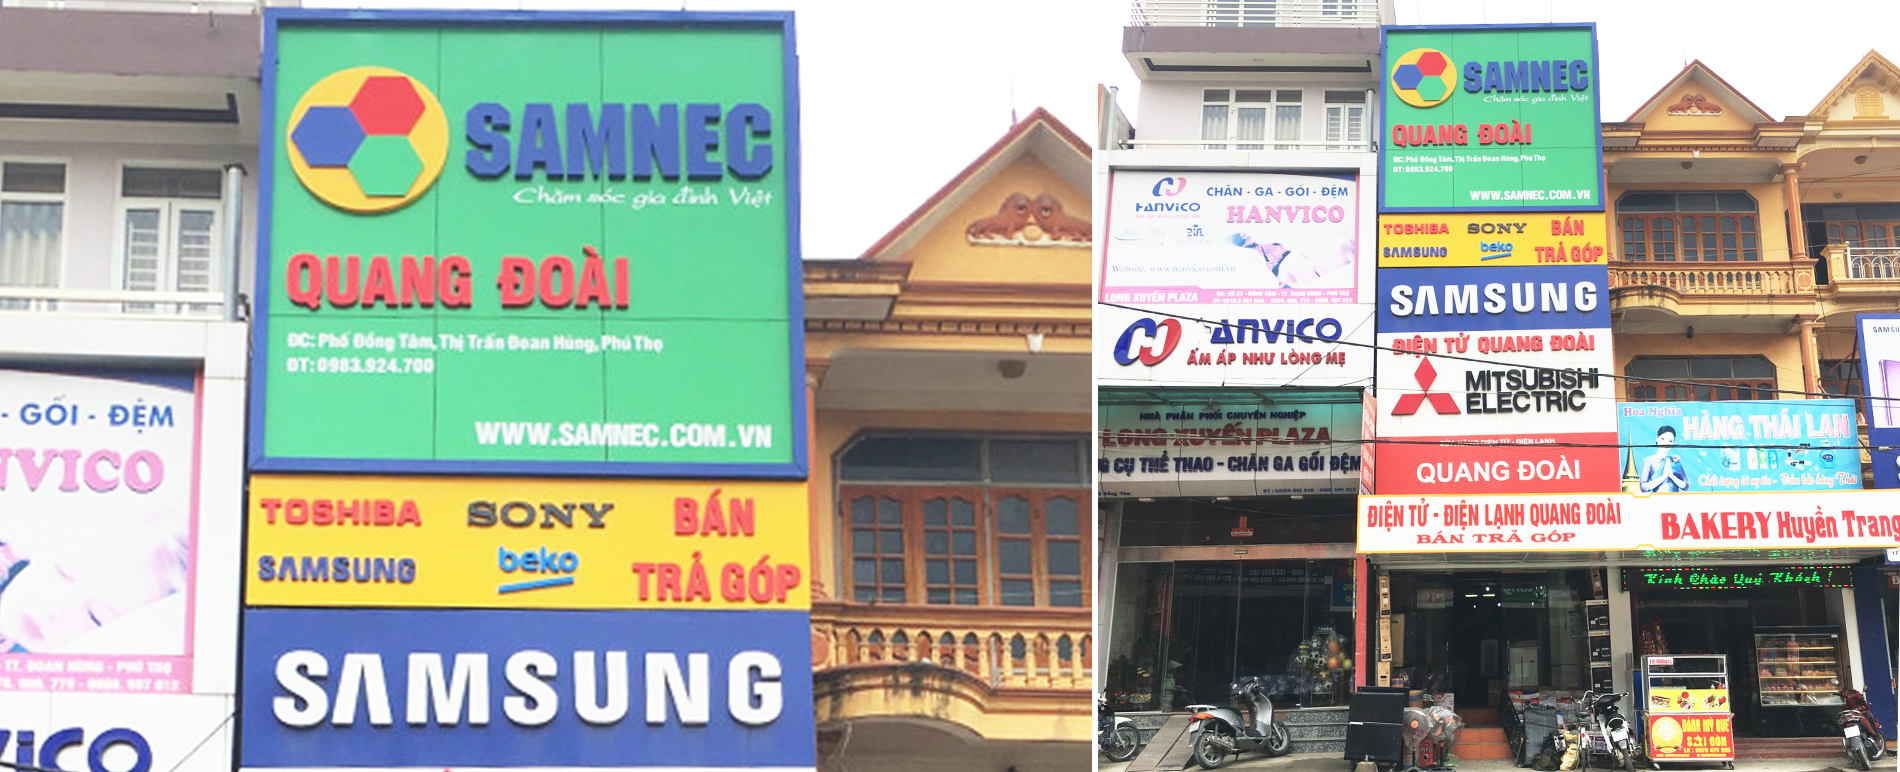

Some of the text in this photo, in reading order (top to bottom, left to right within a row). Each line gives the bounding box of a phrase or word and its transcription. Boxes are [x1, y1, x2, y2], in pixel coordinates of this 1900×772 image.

[1464, 59, 1589, 94] SAMNEC
[1531, 96, 1547, 105] gia
[1548, 93, 1567, 103] đình
[1571, 93, 1588, 104] Việt
[465, 102, 773, 183] SAMNEC
[1392, 118, 1532, 148] QUANG ĐOÀI
[1454, 155, 1465, 164] Thị
[1482, 155, 1500, 163] Đoan
[513, 184, 772, 210] Chăm sóc gia đình Việt
[1206, 184, 1349, 199] CHĂN GA GỐI ĐỆM
[1470, 190, 1591, 200] WWW.SAMNEC.COM.VN
[1226, 204, 1345, 224] HANVICO
[1384, 216, 1584, 236] TOSHIBA SONY BÁN
[1383, 241, 1603, 262] SAMSUNG beko TRẢ GÓP
[286, 245, 631, 311] QUANG ĐOÀI
[1112, 264, 1236, 273] Website: www.hanvico.com.vn
[1105, 292, 1132, 303] LONG
[1167, 292, 1198, 303] PLAZA
[1390, 281, 1597, 316] SAMSUNG
[286, 330, 664, 353] ĐC: Phố Đồng Tâm, Thị Trấn Đoan Hùng, Phú Thọ
[1393, 331, 1594, 357] ĐIỆN TỬ QUANG ĐOÀI
[286, 357, 434, 374] ĐT: 0983.924.700
[1187, 347, 1346, 367] ẤM ÁP NHƯ LÒNG MẸ
[1465, 368, 1599, 414] MITSUBISHI ELECTRIC
[19, 394, 175, 435] GỐI ĐỆM
[1140, 409, 1307, 421] NHÀ PHÂN PHỐI CHUYÊN NGHIỆP
[1623, 405, 1683, 418] Hoa Nghĩa
[1683, 408, 1850, 441] HÀNG THÁI LAN
[475, 421, 772, 448] WWW.SAMNEC.COM.VN
[1102, 427, 1167, 447] LONG
[1256, 426, 1331, 446] PLAZA
[0, 447, 165, 494] VICO
[1113, 456, 1135, 476] CỤ
[1139, 450, 1170, 473] THỂ
[1173, 456, 1214, 472] THAO
[1227, 451, 1269, 472] CHĂN
[1273, 456, 1294, 472] GA
[1299, 450, 1325, 472] GỐI
[1329, 454, 1360, 474] ĐỆM
[1417, 455, 1581, 483] QUANG ĐOÀI
[260, 488, 756, 537] TOSHIBA SONY BÁN
[1367, 498, 1622, 532] ĐIỆN TỬ ĐIỆN LẠNH QUANG ĐOÀI
[1660, 505, 1900, 543] BAKERY Huyền Trang
[1417, 529, 1576, 544] BÁN TRẢ GÓP
[257, 546, 802, 605] SAMSUNG beko TRẢ GÓP
[272, 649, 785, 729] SAMSUNG
[1682, 716, 1701, 732] BÁNH
[1702, 716, 1714, 732] MỲ
[1709, 734, 1727, 747] GÒN
